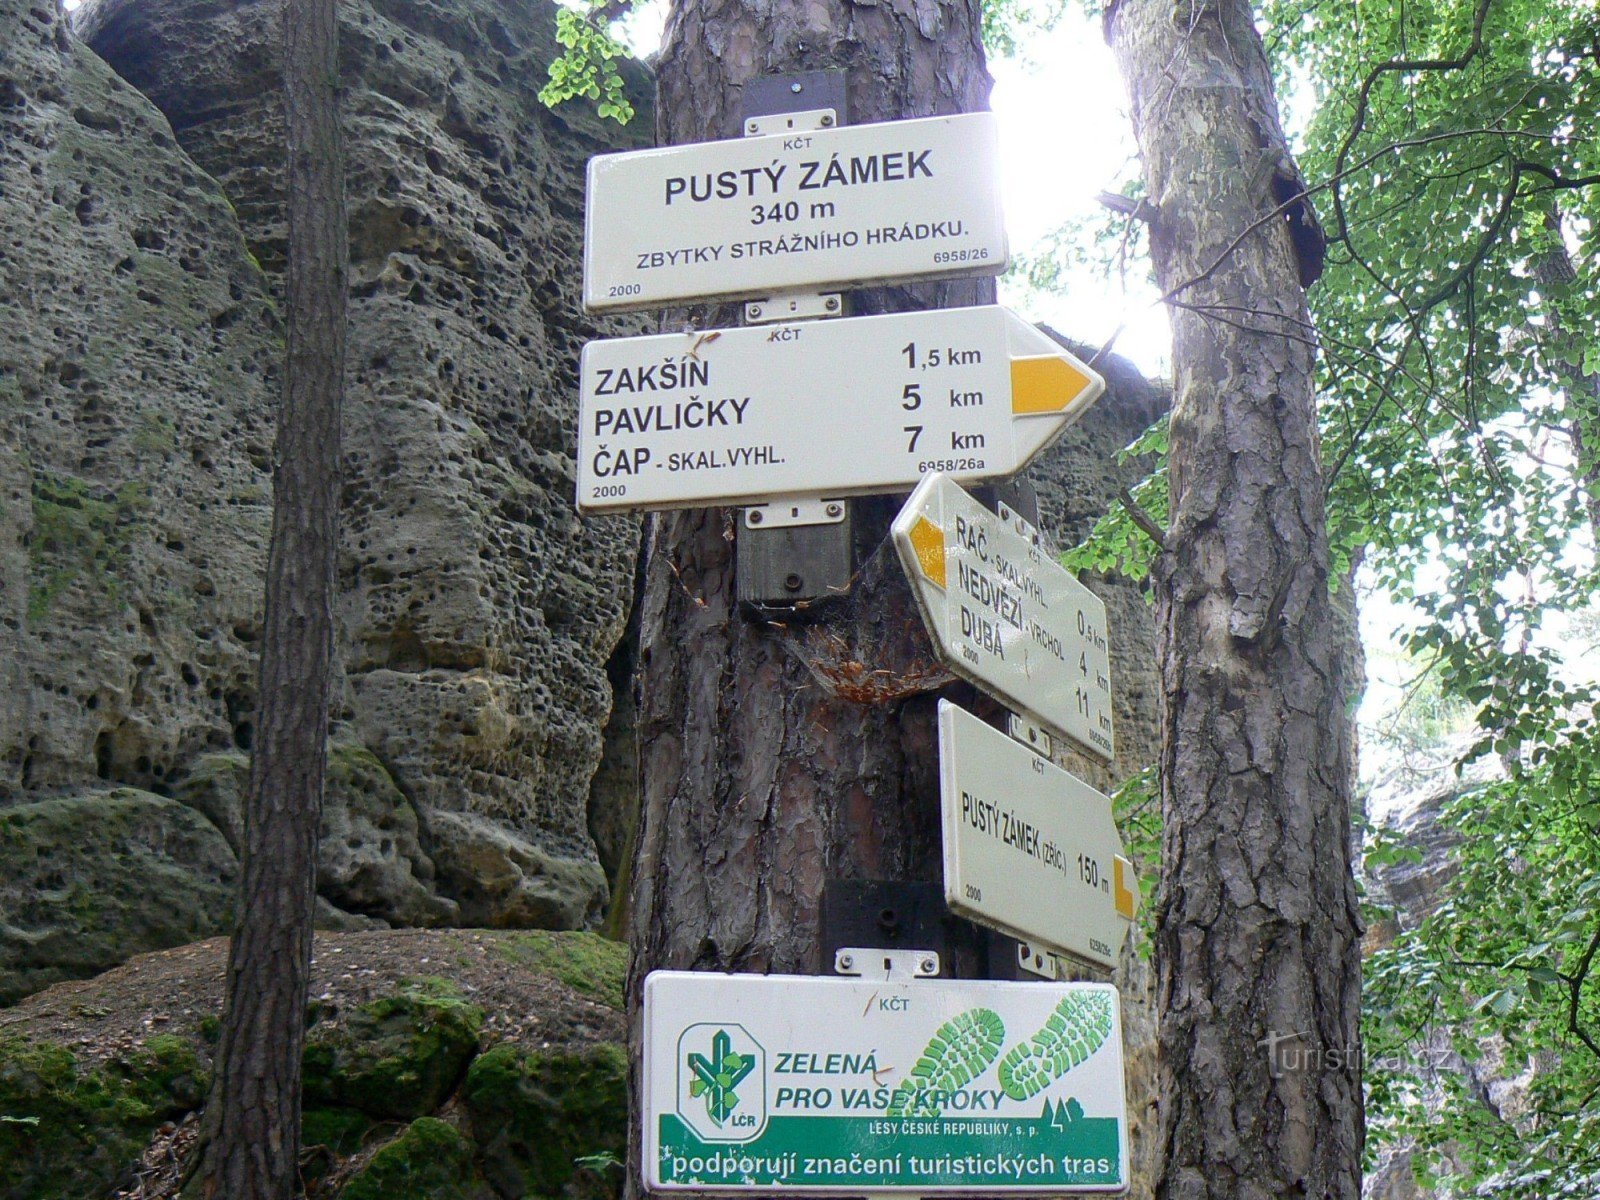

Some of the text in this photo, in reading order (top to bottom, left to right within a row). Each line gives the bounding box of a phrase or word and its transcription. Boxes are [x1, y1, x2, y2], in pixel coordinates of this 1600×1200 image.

[783, 137, 813, 151] KČT
[664, 149, 933, 205] PUSTÝ ZÁMEK
[750, 200, 836, 226] 340 m
[637, 219, 969, 270] ZBYTKY STRÁŽNÍHO HRÁDKU.
[933, 248, 988, 264] 6958/26
[609, 283, 641, 297] 2000
[770, 327, 802, 342] KČT
[594, 342, 982, 396] ZAKŠÍN 1,5 km
[594, 384, 984, 436] PAVLIČKY 5 km
[592, 445, 651, 477] ČAP
[668, 446, 785, 470] SKAL.VYHL.
[904, 426, 923, 453] 7
[951, 430, 985, 450] km
[592, 484, 627, 498] 2000
[956, 514, 988, 562] RAČ
[1093, 629, 1106, 653] km
[959, 562, 1023, 631] NEDVĚZÍ
[1029, 619, 1065, 661] VRCHOL
[1079, 651, 1087, 677] 4
[1096, 669, 1109, 693] km
[963, 644, 979, 665] 2000
[961, 605, 1111, 733] DUBÁ 11 km
[1032, 758, 1044, 775] KČT
[962, 791, 1000, 838] PUSTÝ
[1003, 809, 1041, 859] ZÁMEK
[1077, 852, 1098, 888] 150
[1101, 878, 1109, 893] m
[966, 884, 982, 902] 2000
[879, 996, 910, 1011] KČT
[774, 1049, 878, 1074] ZELENÁ
[774, 1084, 1007, 1109] PRO VAŠE KROKY
[731, 1112, 756, 1127] LČR
[869, 1120, 898, 1135] LESY
[901, 1117, 940, 1135] ČESKÉ
[943, 1120, 1013, 1137] REPUBLIKY,
[671, 1151, 1110, 1178] podporují značení turistických tras
